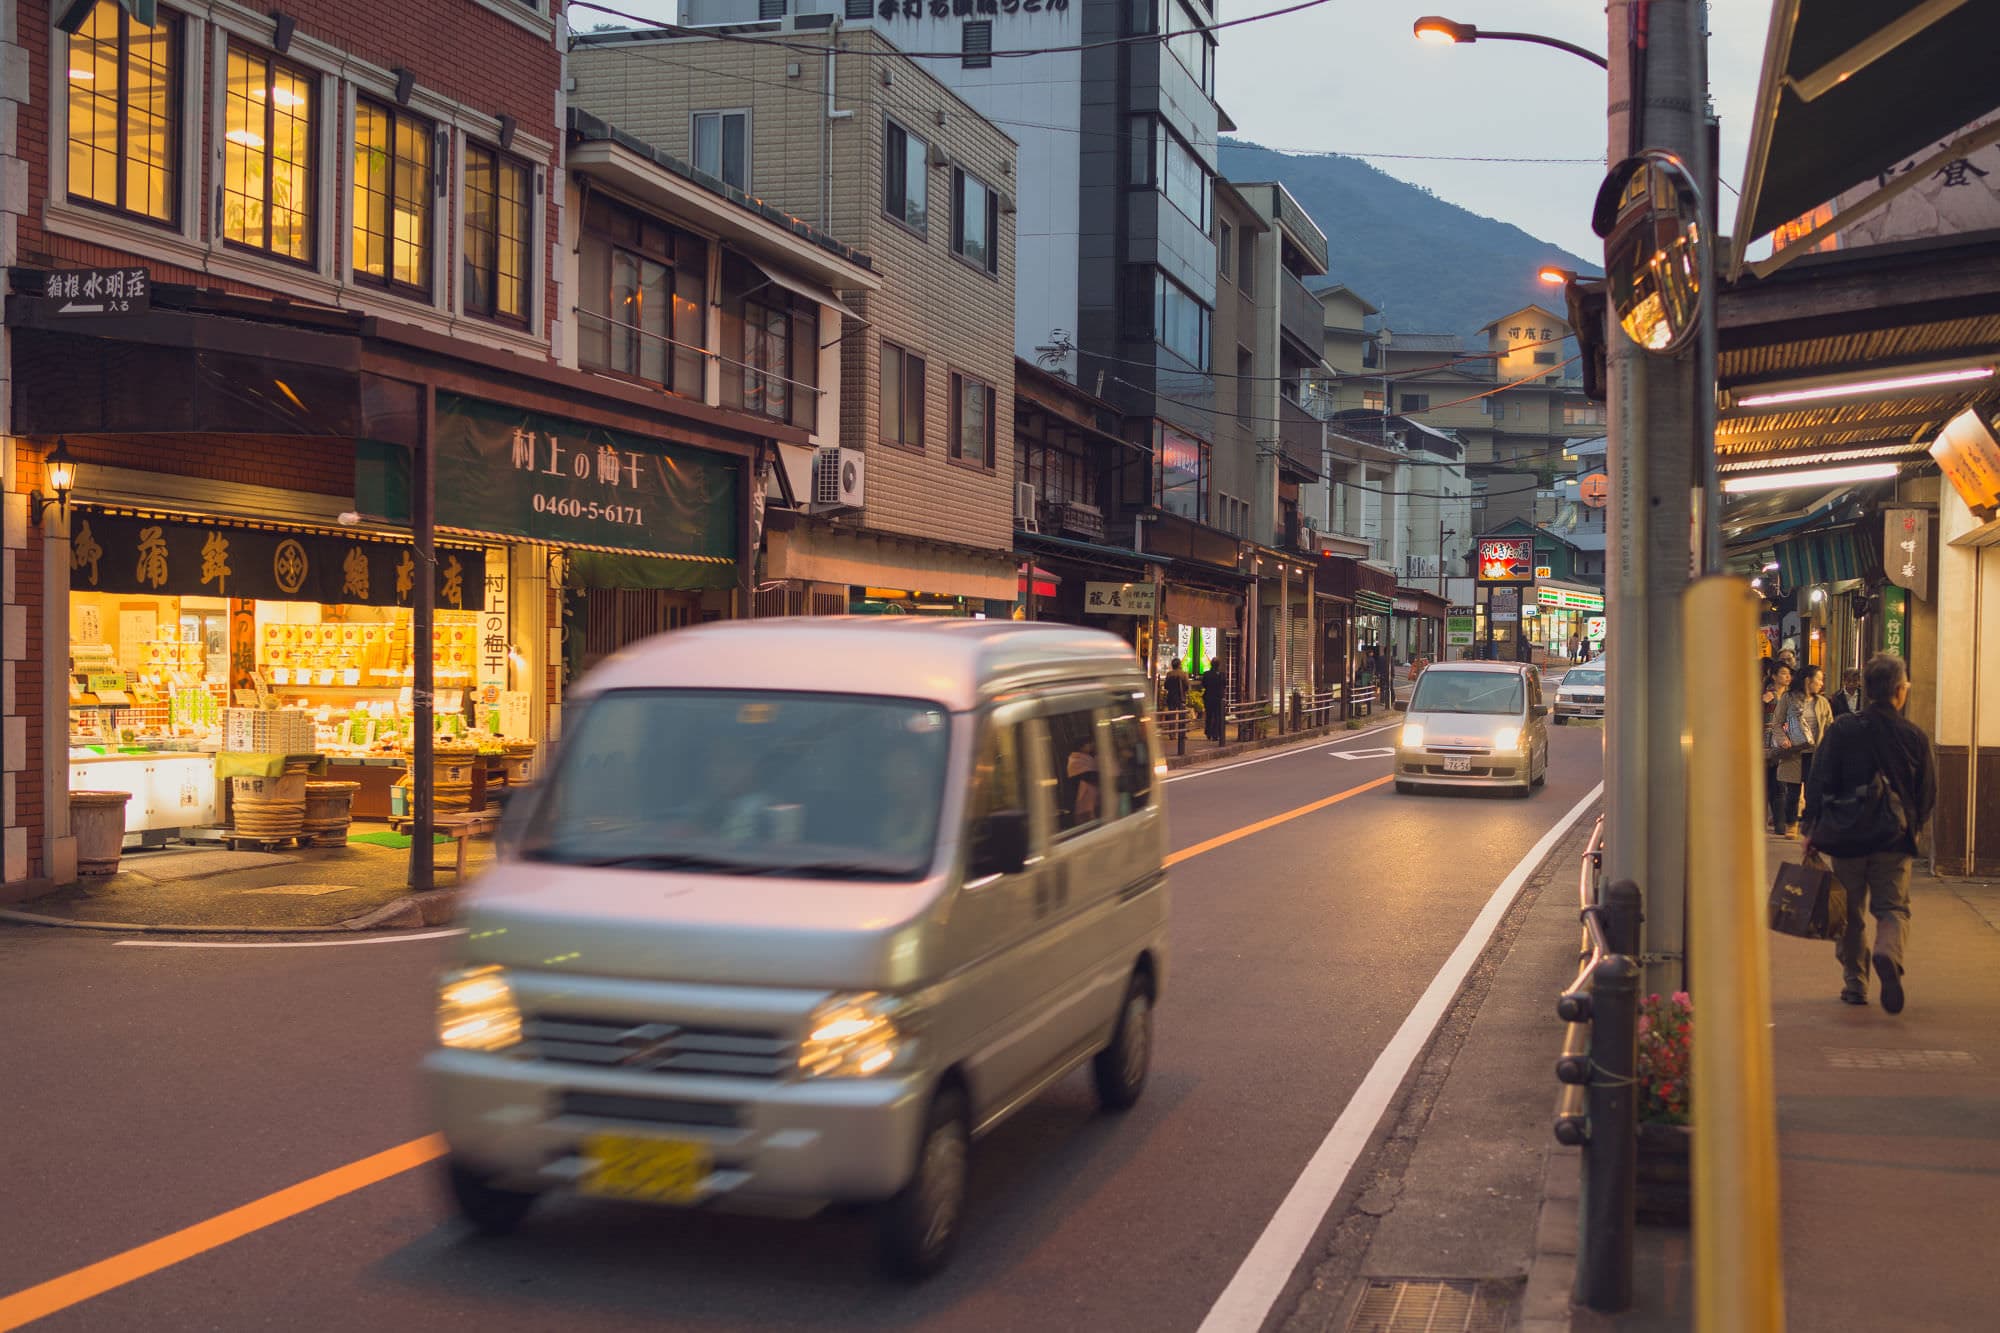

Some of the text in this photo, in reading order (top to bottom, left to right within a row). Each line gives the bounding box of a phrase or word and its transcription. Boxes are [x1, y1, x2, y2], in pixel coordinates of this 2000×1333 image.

[47, 270, 146, 299] 箱根水明荘
[108, 300, 130, 312] 入る
[511, 427, 645, 489] 村上の梅干
[532, 493, 644, 526] 0460-5-6171
[1481, 542, 1530, 561] やじきたの湯
[484, 573, 505, 675] 村上の梅干
